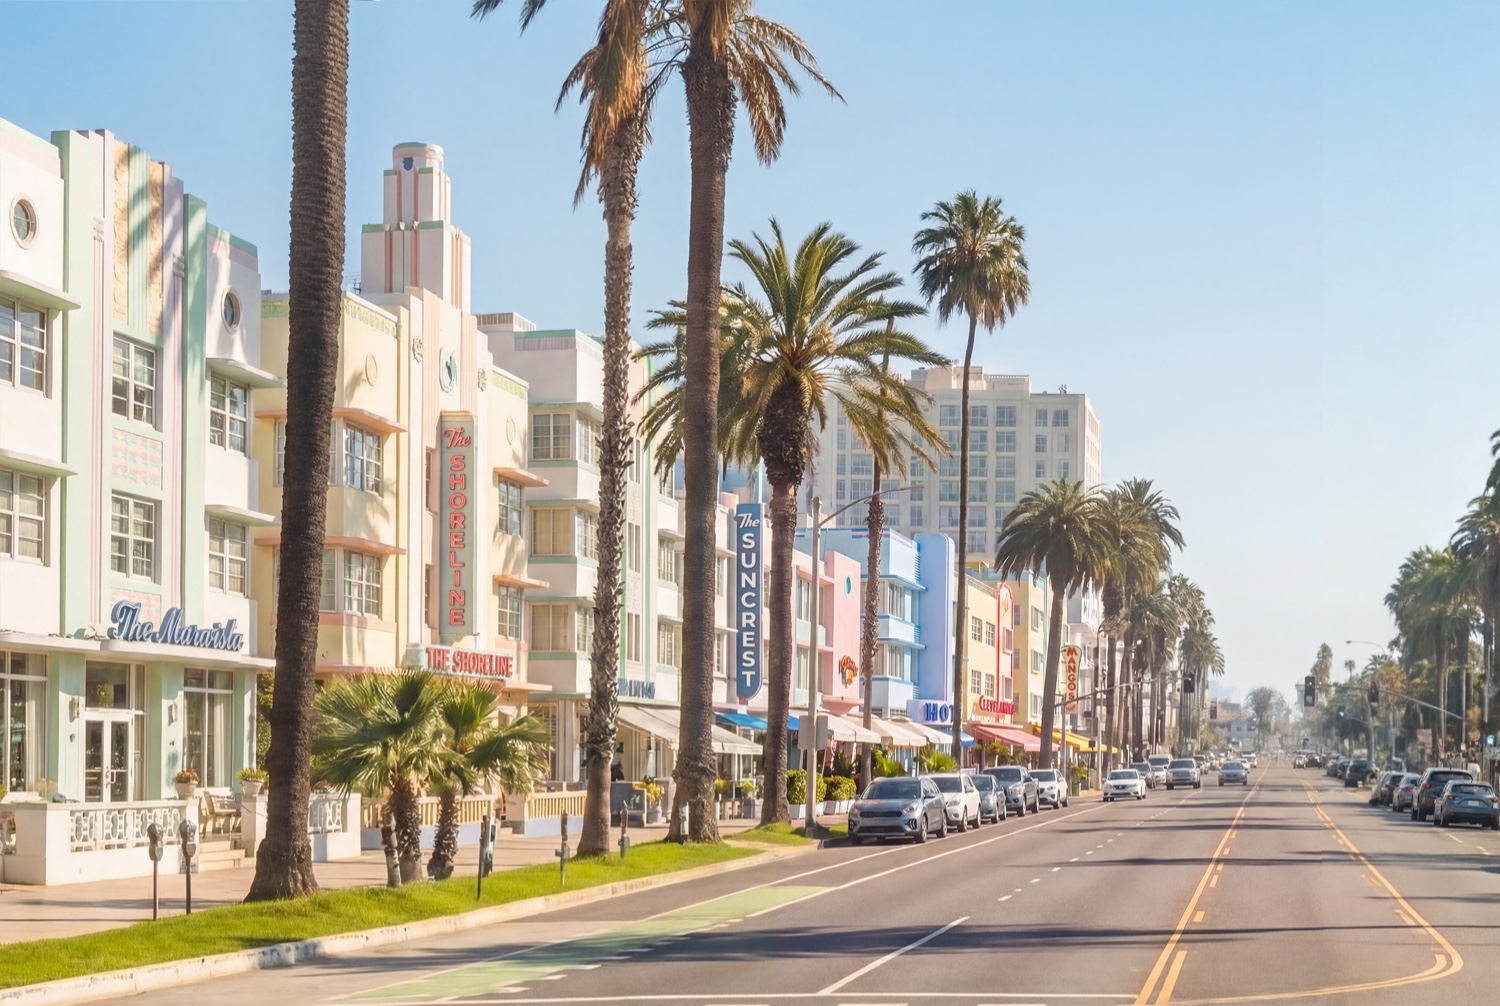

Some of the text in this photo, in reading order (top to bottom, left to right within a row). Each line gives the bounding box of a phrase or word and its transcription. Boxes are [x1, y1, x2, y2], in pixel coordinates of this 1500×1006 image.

[443, 427, 471, 449] The
[449, 454, 467, 626] SHORELINE
[737, 513, 760, 529] The
[107, 600, 244, 652] The Maravista
[741, 533, 756, 687] SUNCREST
[426, 647, 513, 677] THE SHORELINE
[1066, 646, 1078, 700] MANGOS
